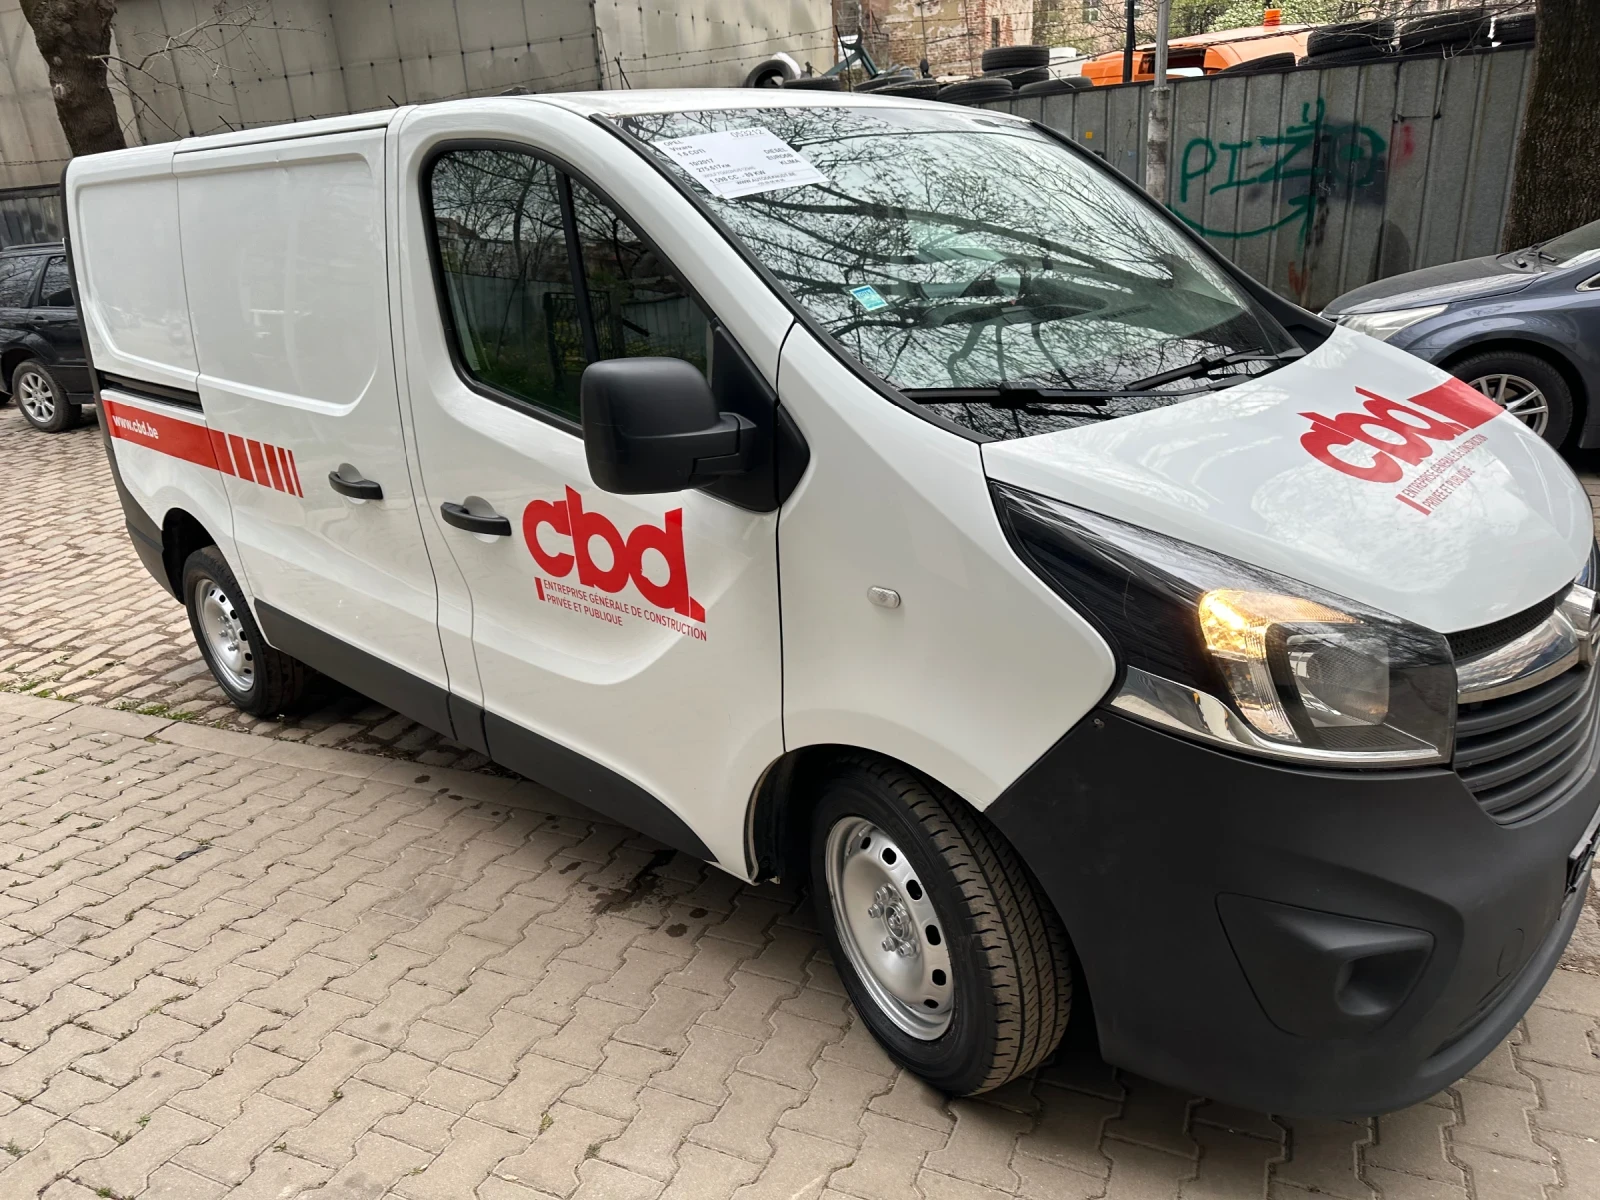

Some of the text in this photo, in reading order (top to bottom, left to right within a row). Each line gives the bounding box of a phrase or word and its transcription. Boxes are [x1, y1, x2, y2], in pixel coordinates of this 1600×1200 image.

[112, 415, 159, 440] www.cbd.be
[543, 580, 707, 641] ENTREPRISE GÉNÉRALE DE CONSTRUCTION
[546, 594, 623, 626] PRIVÉE ET PUBLIQUE
